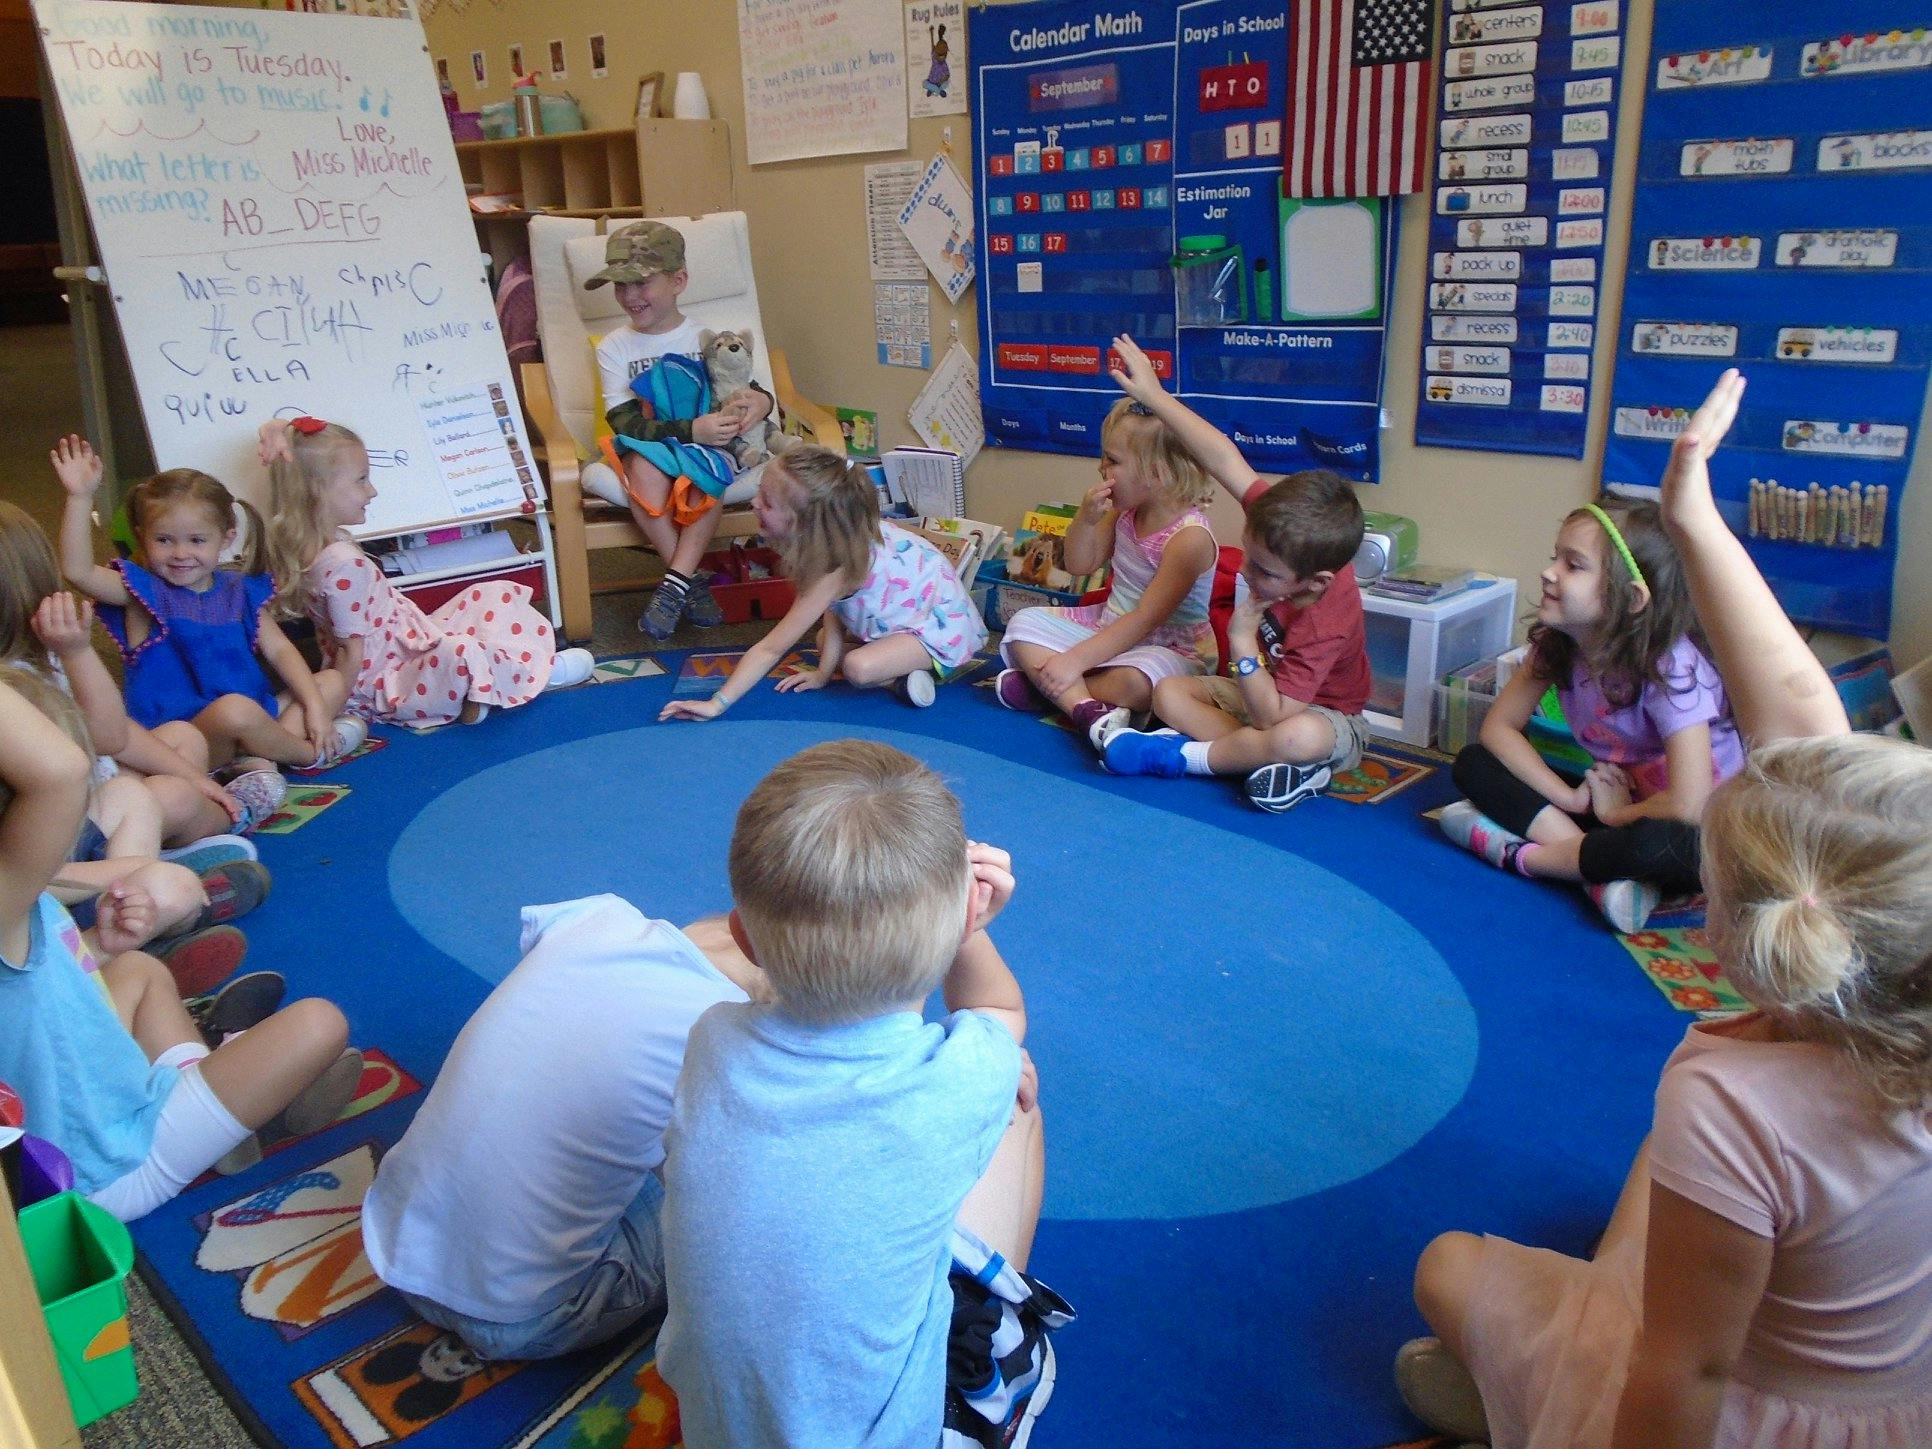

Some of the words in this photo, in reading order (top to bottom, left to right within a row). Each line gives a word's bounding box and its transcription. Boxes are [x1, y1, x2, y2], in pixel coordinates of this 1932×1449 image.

[911, 8, 930, 23] Rug
[933, 3, 960, 17] Rules
[1010, 22, 1090, 52] Calendar
[1094, 11, 1143, 38] Math
[1184, 22, 1218, 43] Days
[1222, 19, 1236, 36] in
[1239, 13, 1285, 33] School
[1483, 13, 1539, 32] centers
[53, 40, 165, 82] Today
[184, 46, 213, 73] is
[223, 45, 352, 93] Tuesday.
[1485, 50, 1525, 67] snack
[1706, 59, 1743, 78] Art
[62, 79, 101, 107] We
[118, 77, 166, 106] will
[177, 86, 205, 113] go
[218, 83, 247, 107] to
[1040, 76, 1104, 99] September
[1205, 81, 1218, 98] H
[1227, 78, 1237, 96] T
[1247, 77, 1260, 95] O
[1465, 85, 1496, 99] whole
[1503, 83, 1533, 99] group
[337, 116, 396, 147] Love,
[1477, 121, 1524, 138] recess
[293, 150, 345, 181] Miss
[353, 148, 433, 179] Michelle
[998, 159, 1005, 173] 1
[1025, 157, 1032, 170] 2
[1048, 156, 1055, 168] 3
[1073, 154, 1082, 167] 4
[1098, 151, 1106, 164] 5
[1125, 149, 1132, 162] 6
[1153, 143, 1162, 158] 7
[81, 152, 147, 184] What
[160, 151, 234, 181] letter
[236, 159, 261, 182] is
[1482, 164, 1515, 177] group
[997, 200, 1005, 212] 8
[1024, 196, 1031, 209] 9
[1047, 196, 1060, 210] 10
[1071, 195, 1085, 208] 11
[1096, 193, 1110, 206] 12
[1122, 192, 1136, 206] 13
[1149, 190, 1163, 204] 14
[1177, 184, 1251, 202] Estimation
[1478, 190, 1513, 204] lunch
[1203, 204, 1229, 220] Jar
[994, 237, 1008, 251] 15
[1022, 236, 1035, 249] 16
[1047, 236, 1062, 250] 17
[1671, 244, 1752, 263] Science
[1462, 258, 1493, 272] pack
[1498, 259, 1516, 272] up
[1466, 322, 1511, 335] recess
[1555, 325, 1590, 340] 2:40
[1223, 331, 1333, 350] Make-A-Pattern
[1669, 330, 1729, 347] puzzles
[1819, 334, 1886, 353] vehicles
[1005, 351, 1040, 364] Tuesday
[1050, 353, 1097, 366] September
[1463, 352, 1500, 365] snack
[232, 360, 310, 383] ELLA
[1456, 382, 1506, 396] dismissal
[1547, 388, 1584, 404] 3:30
[1060, 421, 1086, 432] Months
[1234, 431, 1254, 445] Days
[1255, 434, 1265, 444] in
[1266, 435, 1297, 446] School
[440, 453, 463, 463] Megan
[464, 446, 489, 457] Carlson
[1337, 442, 1368, 455] Cards
[1028, 516, 1057, 535] Pete
